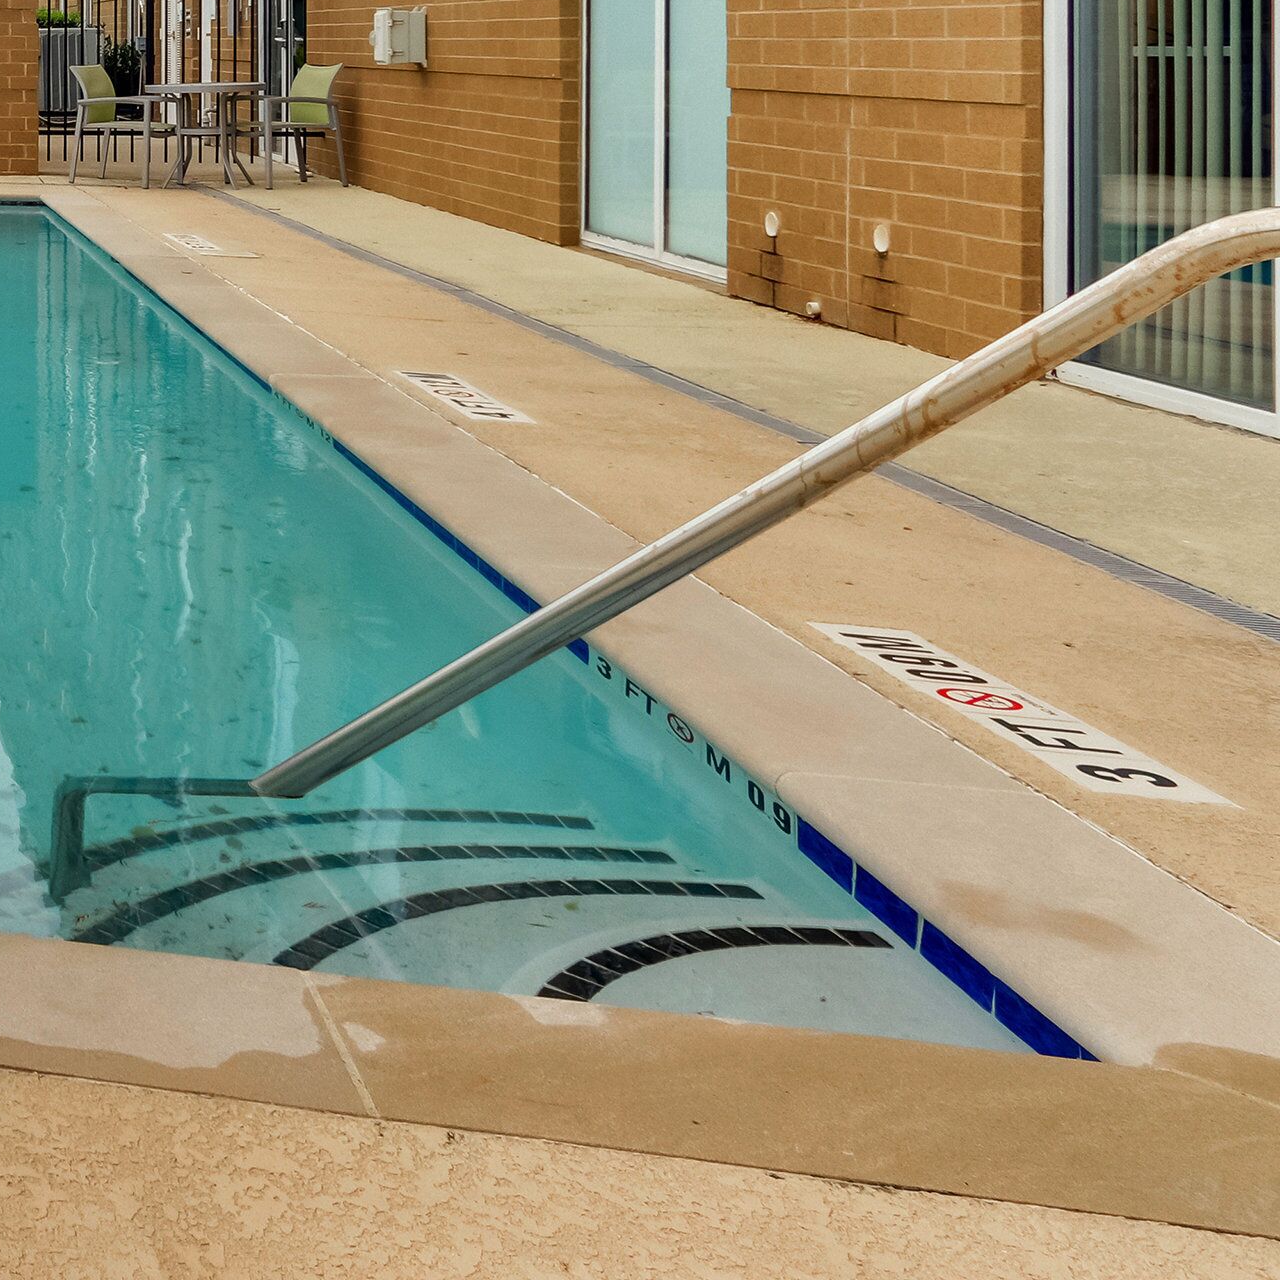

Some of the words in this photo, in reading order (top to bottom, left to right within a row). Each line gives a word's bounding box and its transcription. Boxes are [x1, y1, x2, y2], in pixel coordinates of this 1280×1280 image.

[597, 656, 612, 679] 3
[625, 677, 657, 715] FT
[706, 742, 731, 783] M
[990, 717, 1123, 754] FT
[1075, 764, 1178, 788] 3
